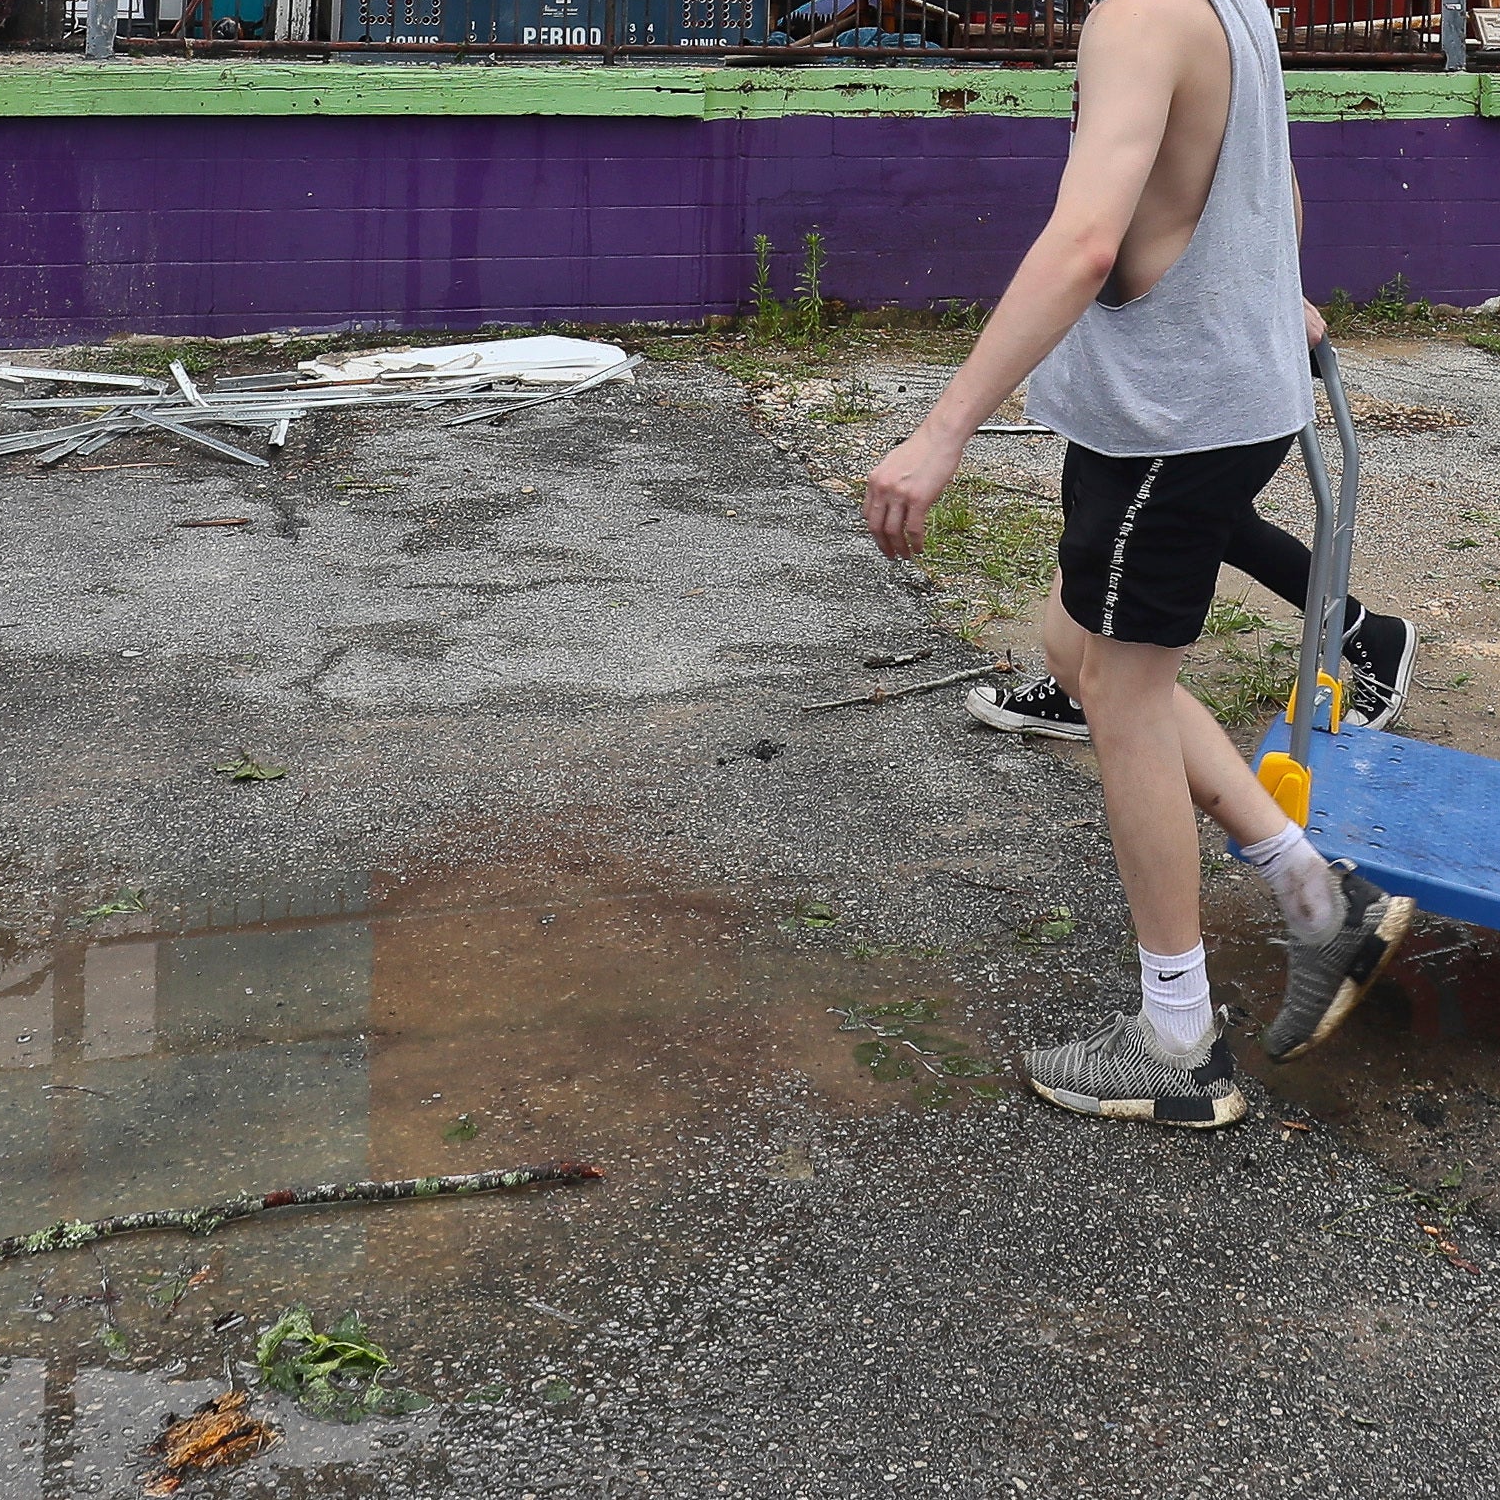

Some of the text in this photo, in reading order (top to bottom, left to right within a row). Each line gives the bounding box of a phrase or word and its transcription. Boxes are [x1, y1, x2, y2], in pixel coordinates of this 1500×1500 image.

[628, 23, 654, 33] 3 4
[523, 27, 602, 46] PERIOD
